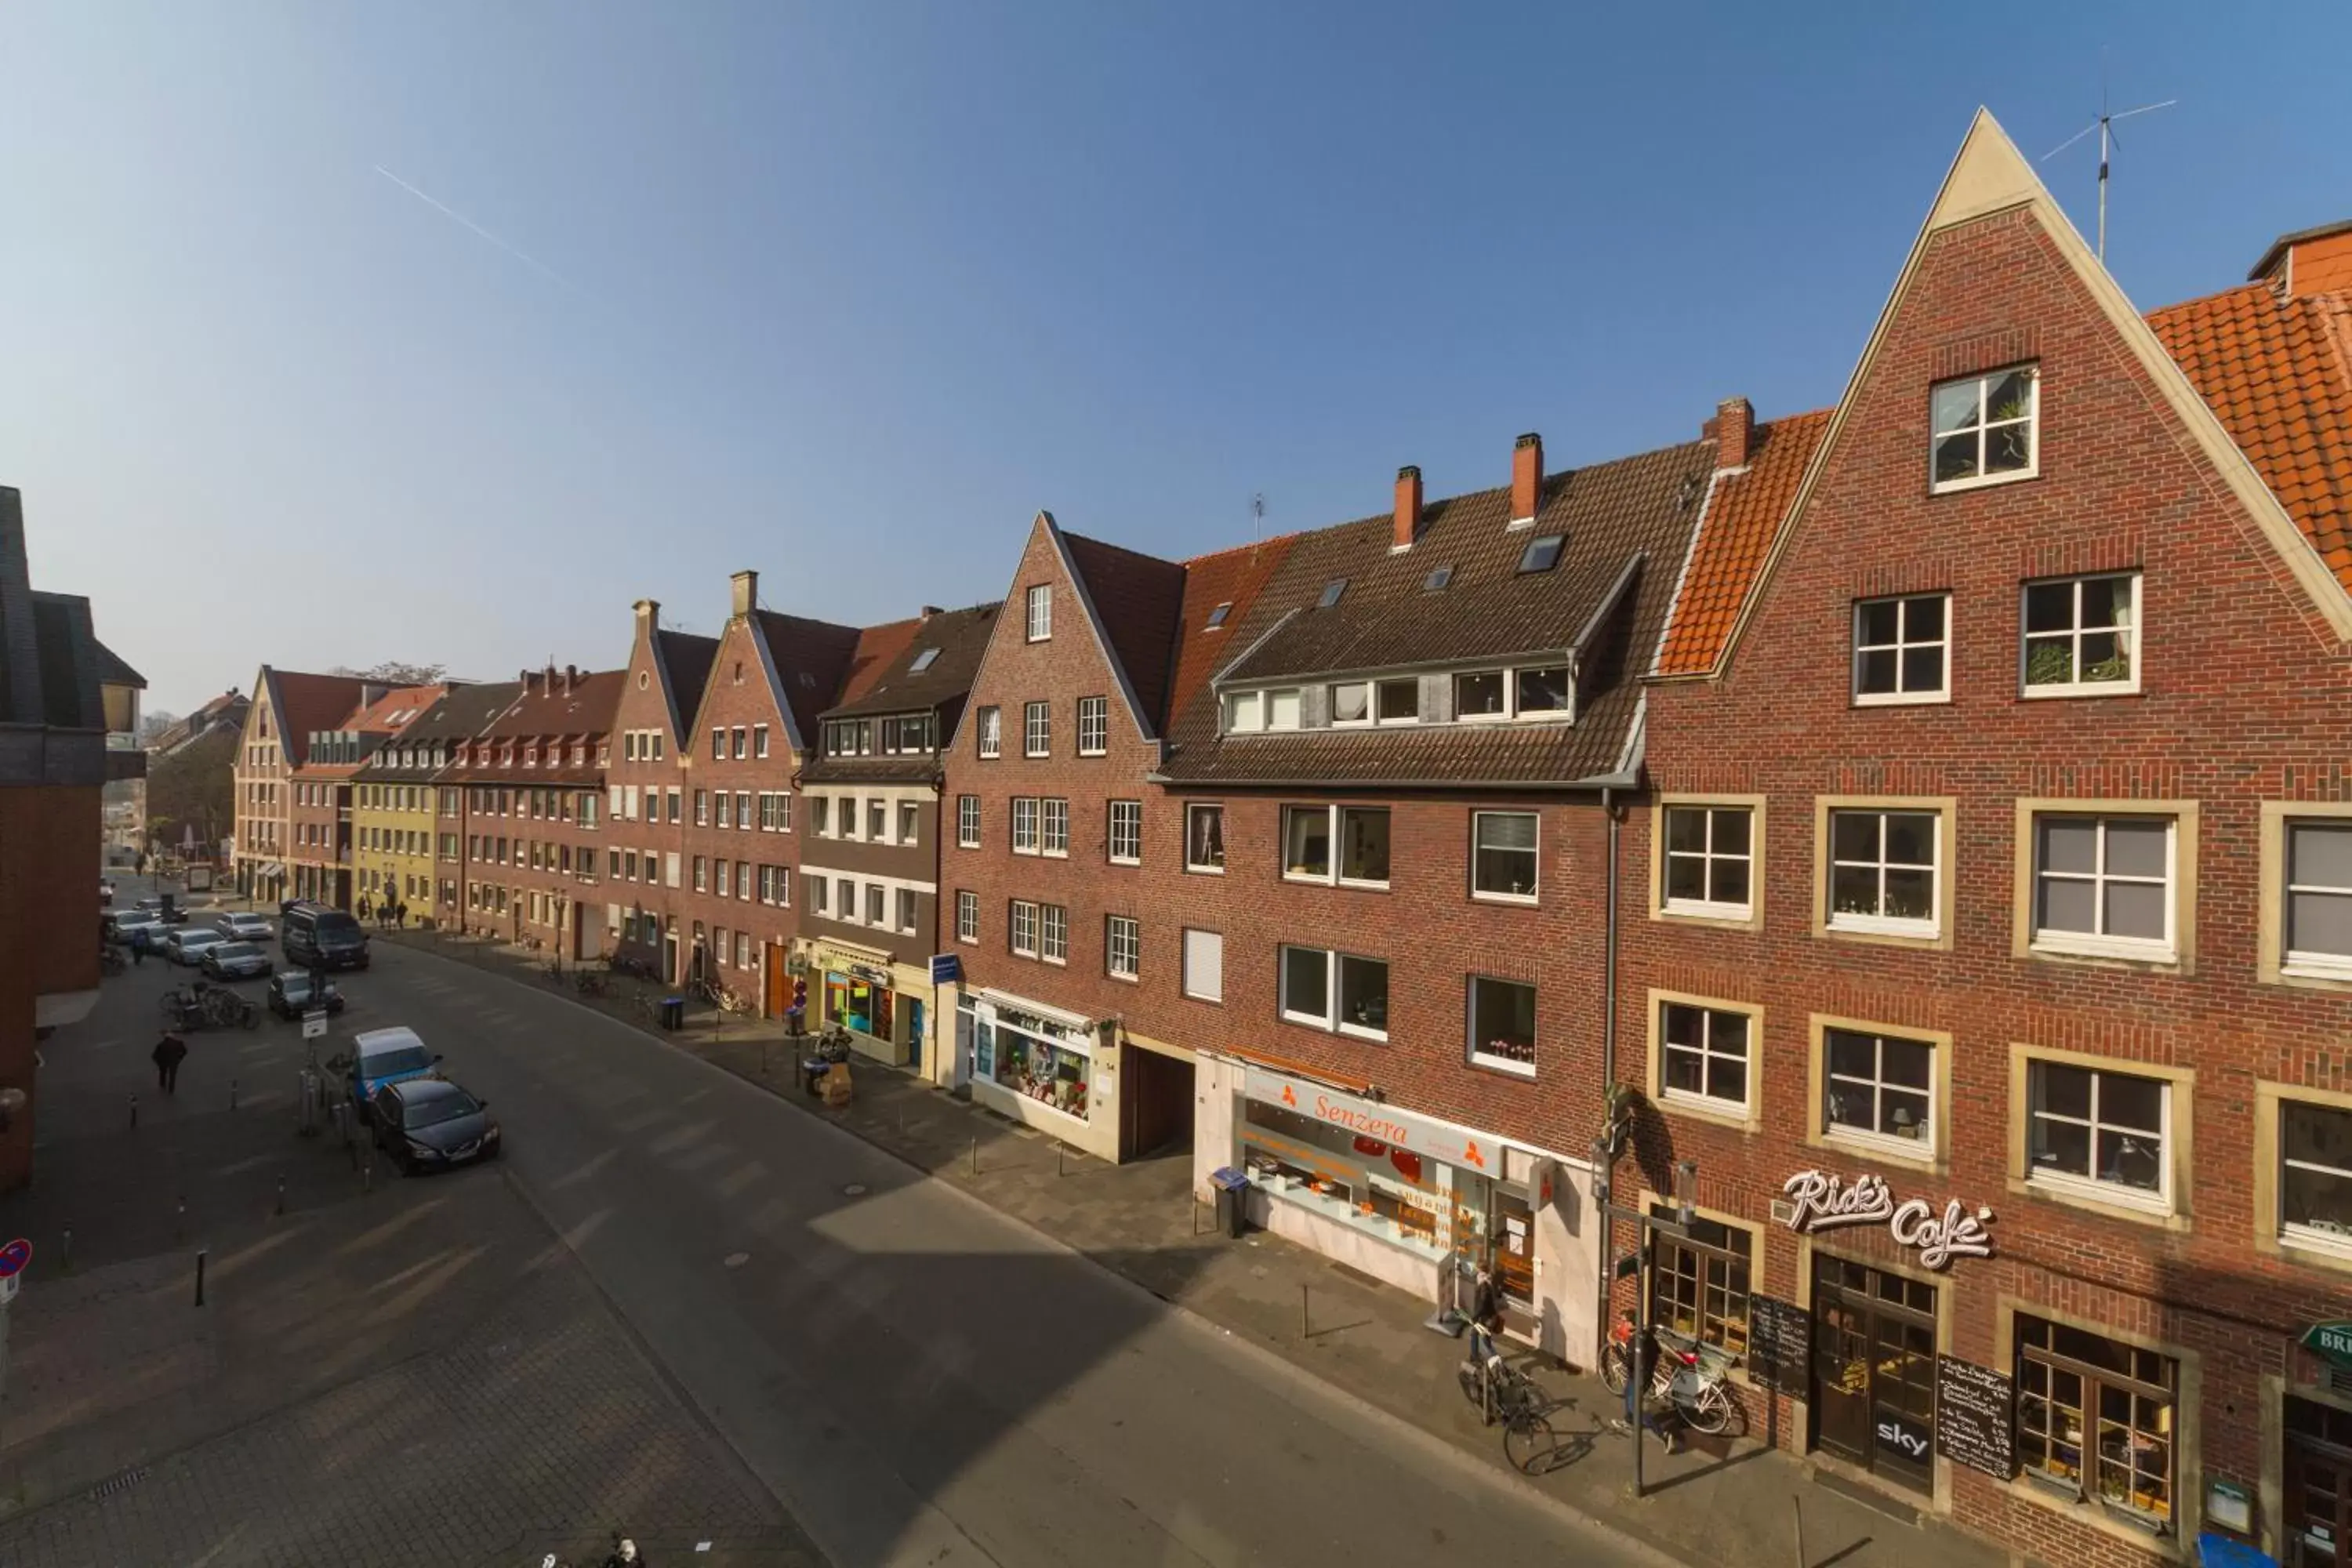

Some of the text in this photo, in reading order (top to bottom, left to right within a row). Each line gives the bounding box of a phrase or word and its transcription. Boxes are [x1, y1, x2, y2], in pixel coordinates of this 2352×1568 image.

[1315, 1094, 1407, 1143] Senzera
[1784, 1170, 1893, 1232] Rick's
[1878, 1423, 1928, 1456] sky
